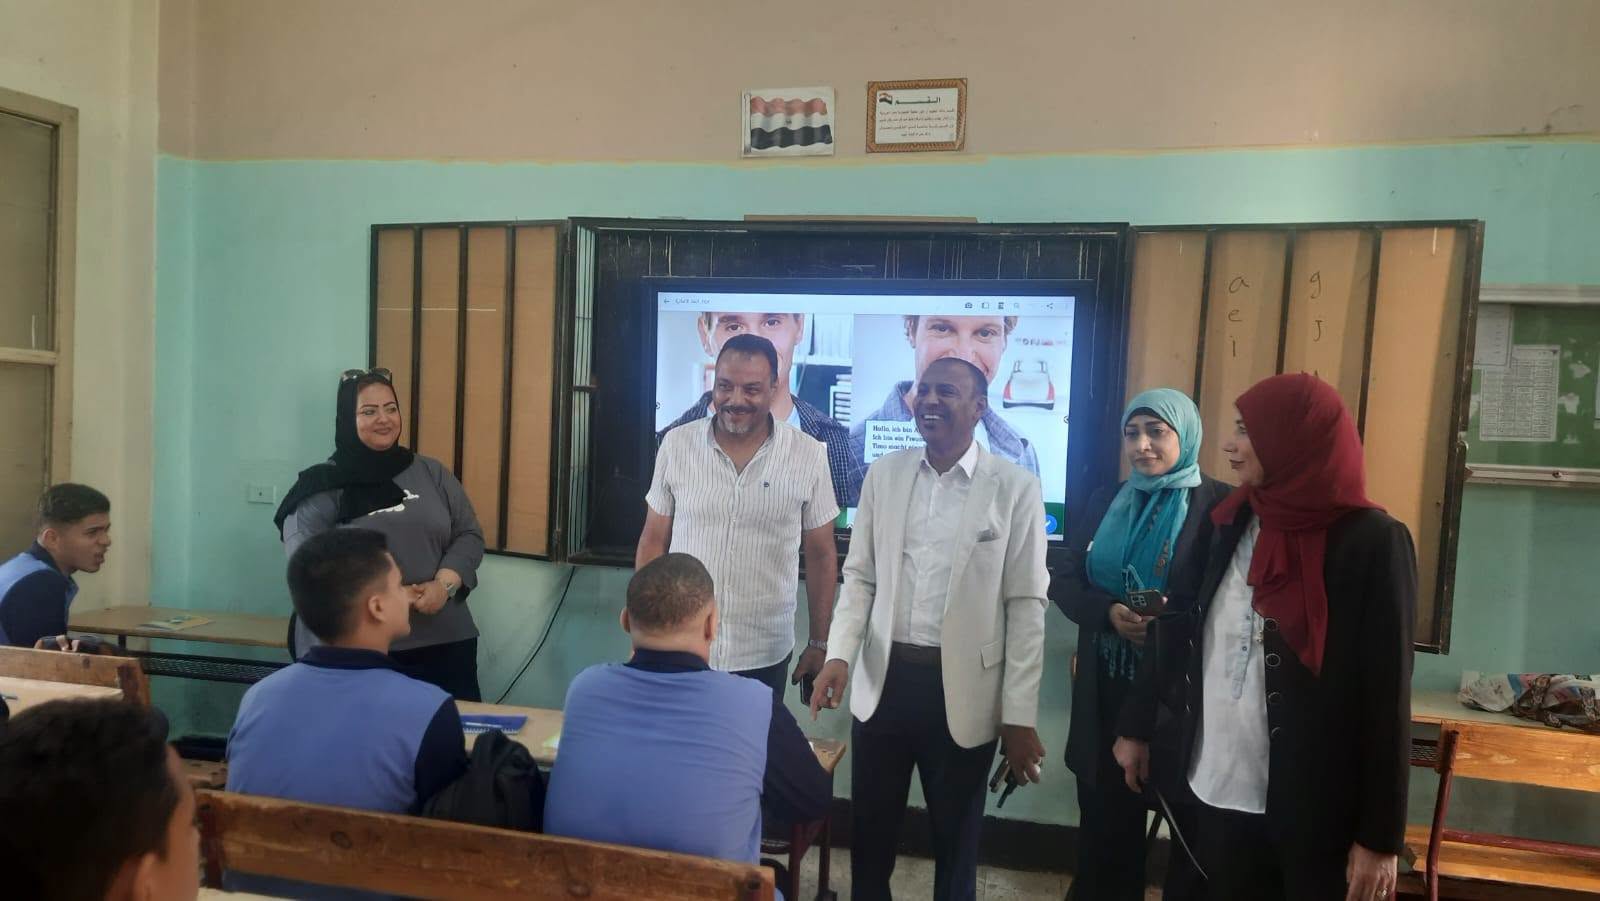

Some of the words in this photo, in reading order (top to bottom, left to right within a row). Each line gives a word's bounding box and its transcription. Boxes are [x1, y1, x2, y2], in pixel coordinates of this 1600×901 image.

[1228, 276, 1249, 294] a
[1309, 271, 1321, 299] g
[1228, 309, 1242, 322] e
[1229, 335, 1237, 358] i
